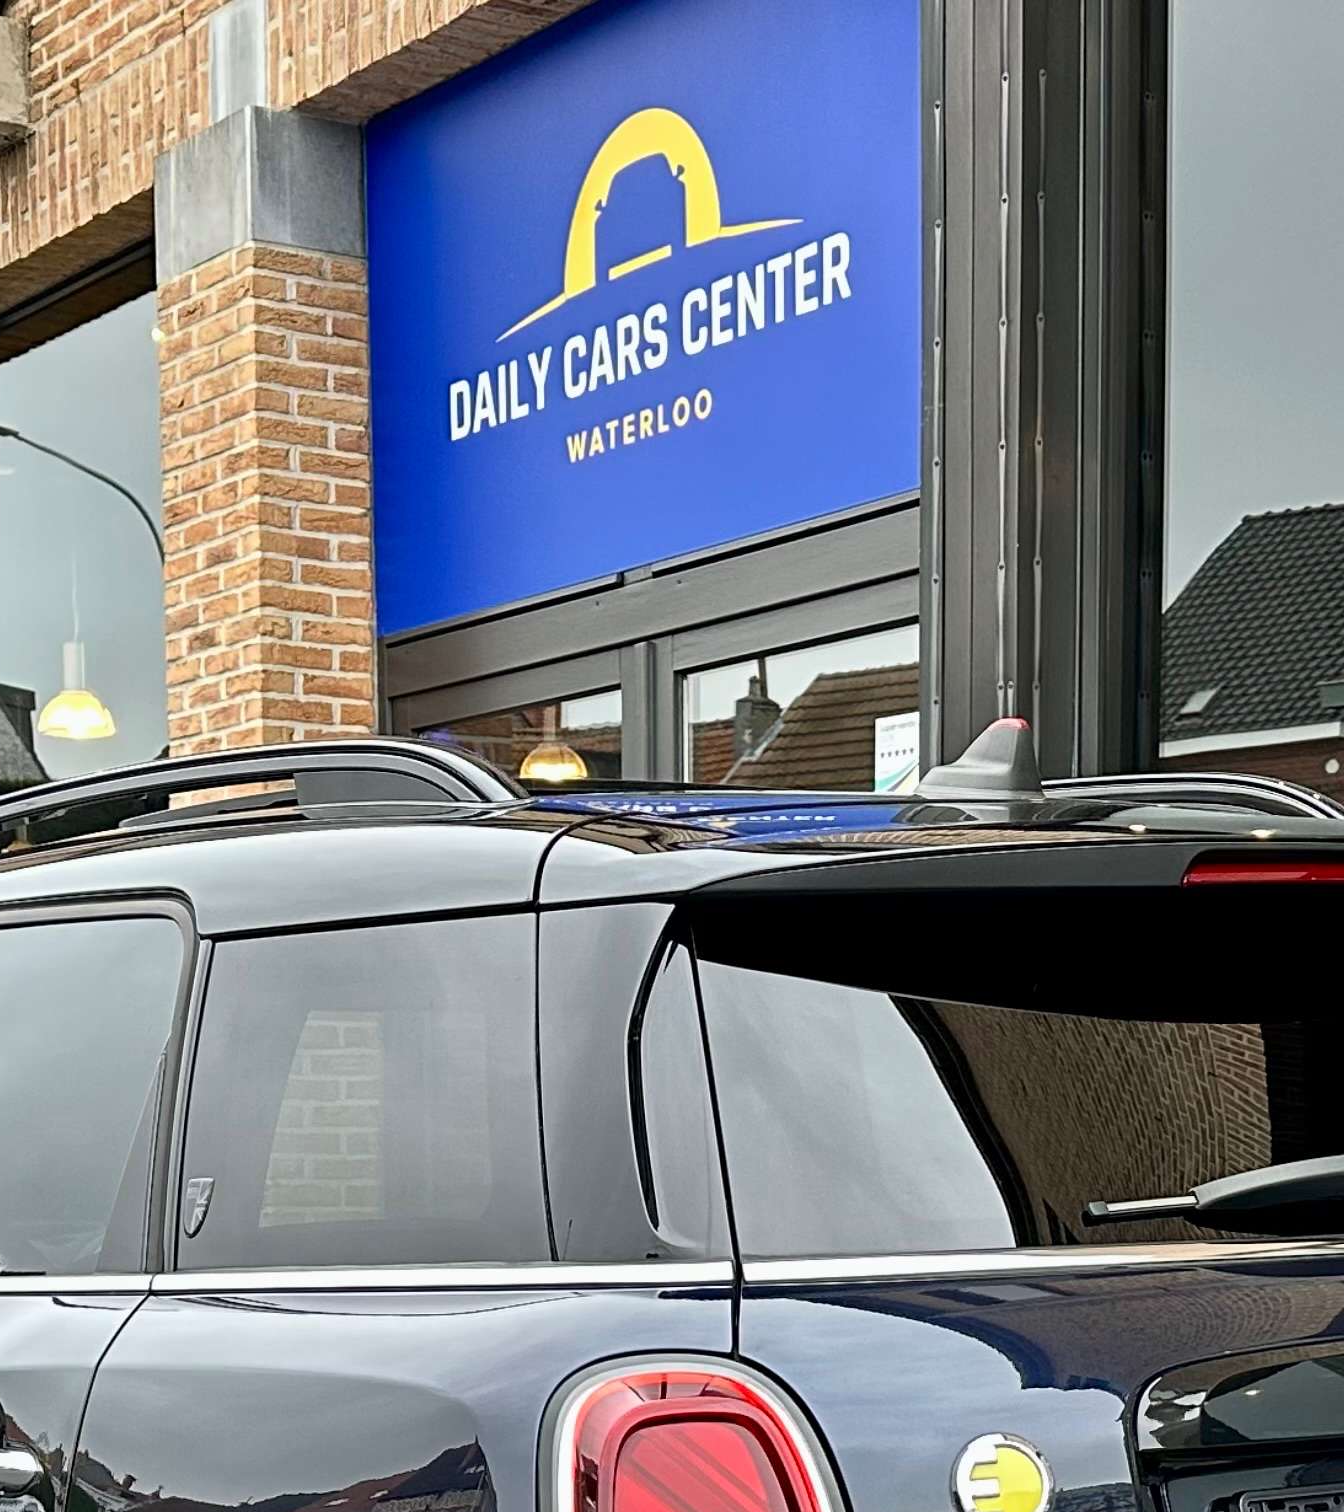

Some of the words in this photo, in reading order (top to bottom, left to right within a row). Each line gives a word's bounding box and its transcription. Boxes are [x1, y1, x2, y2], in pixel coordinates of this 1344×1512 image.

[449, 346, 553, 441] DAILY
[563, 303, 668, 399] CARS
[682, 232, 852, 355] CENTER
[566, 388, 713, 463] WATERLOO
